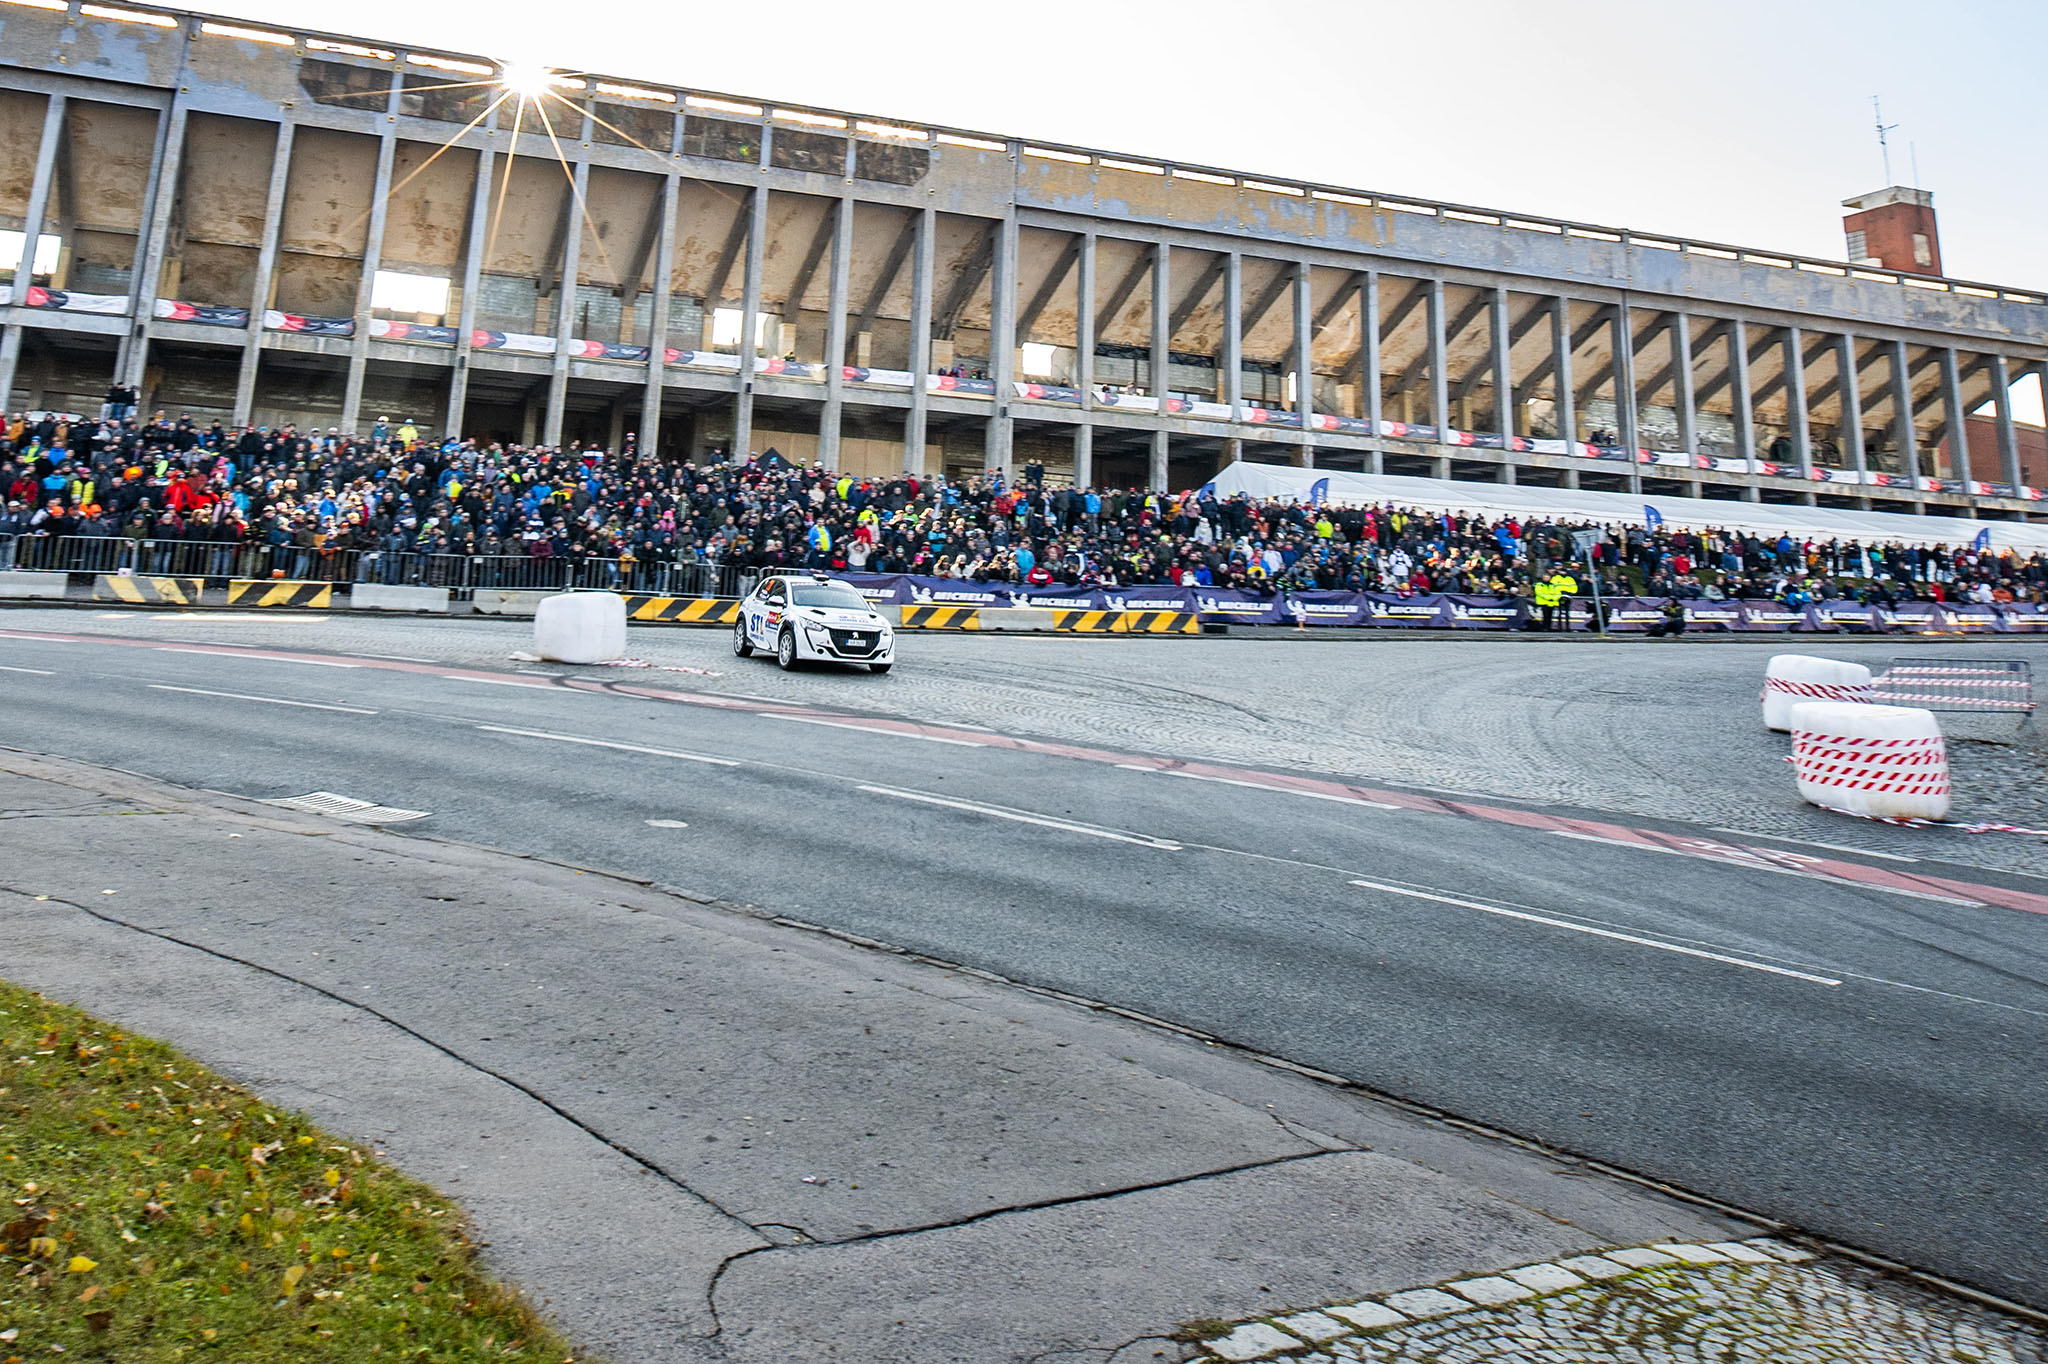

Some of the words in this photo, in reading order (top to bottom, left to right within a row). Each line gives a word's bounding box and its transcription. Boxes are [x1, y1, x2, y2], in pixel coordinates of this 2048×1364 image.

[933, 591, 996, 602] MICHELIN
[1030, 597, 1092, 608] MICHELIN
[1126, 600, 1186, 609] MICHELIN
[1218, 601, 1274, 611] MICHELIN
[1304, 604, 1359, 613] MICHELIN
